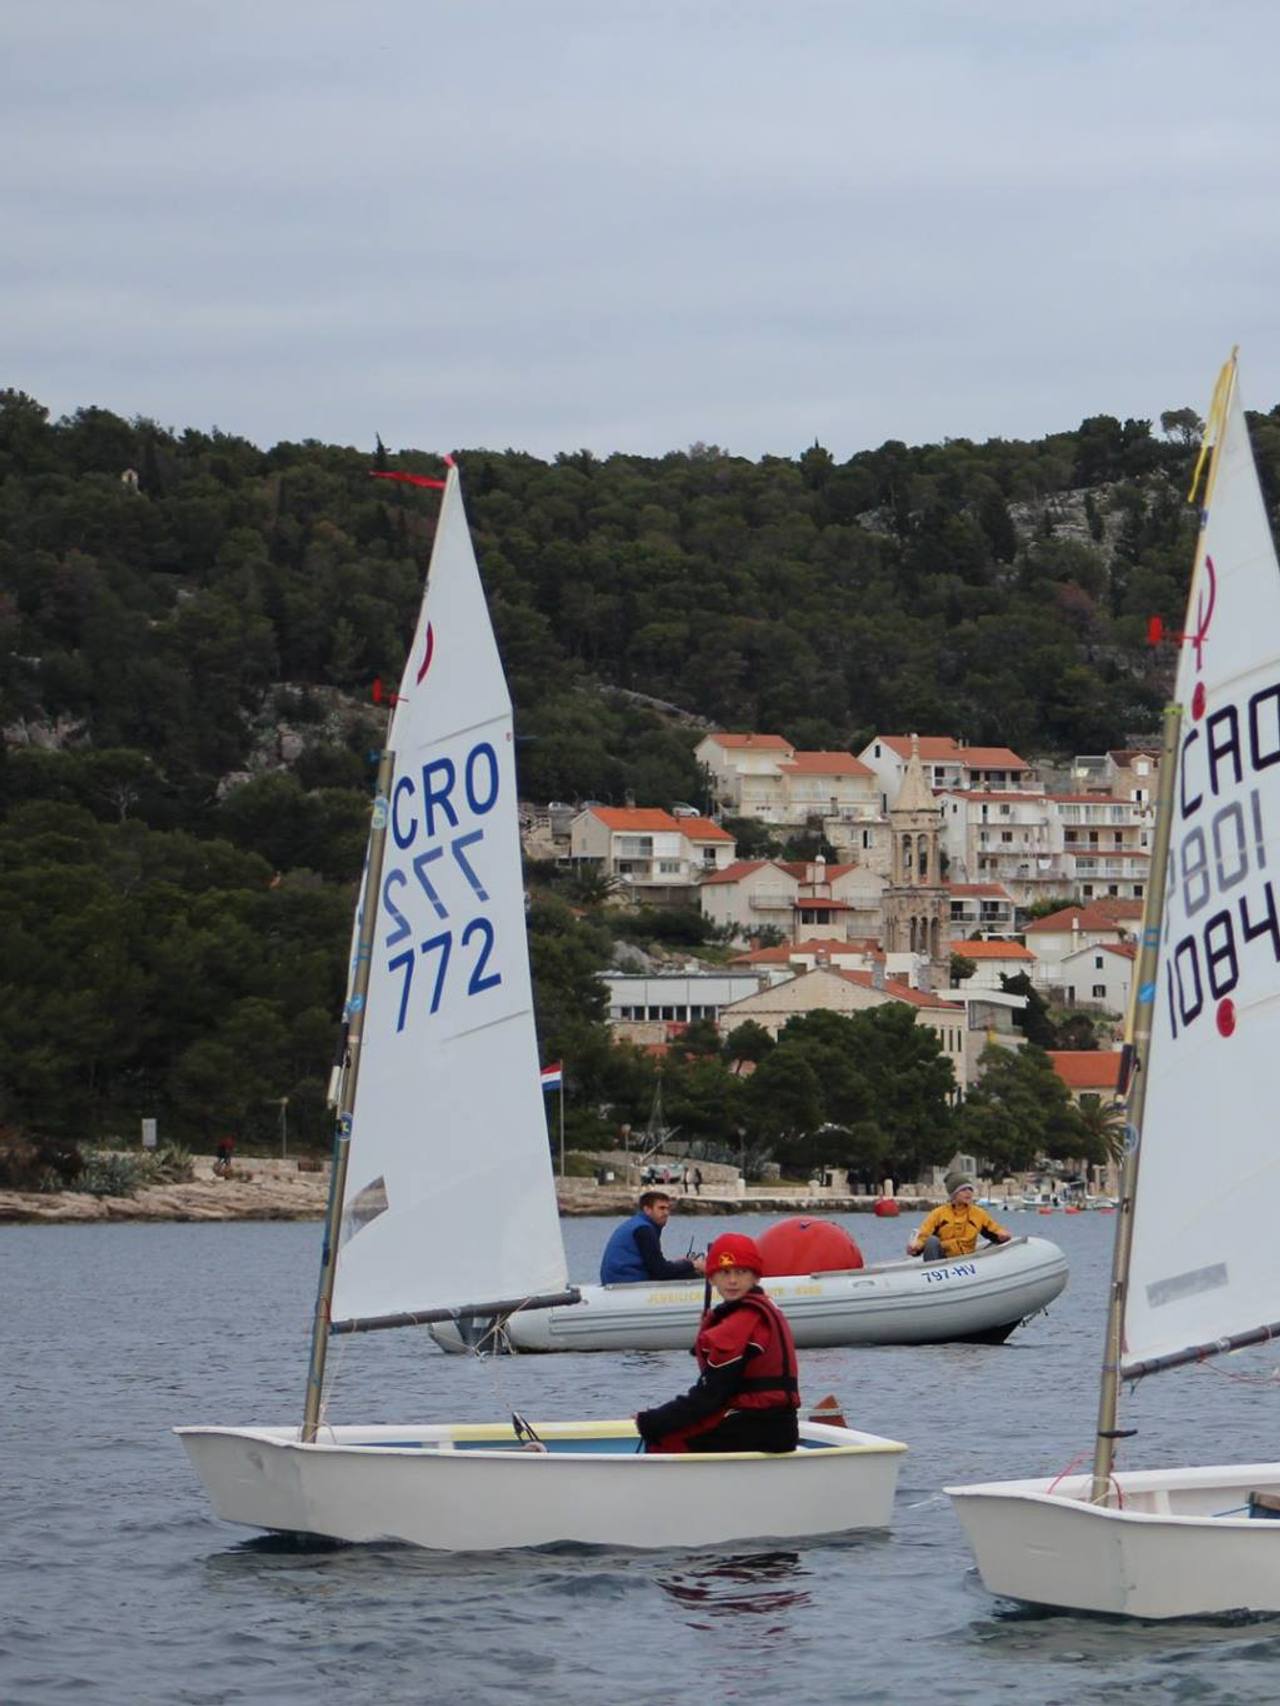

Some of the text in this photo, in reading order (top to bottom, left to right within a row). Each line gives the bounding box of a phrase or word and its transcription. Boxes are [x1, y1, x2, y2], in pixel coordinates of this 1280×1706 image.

[392, 742, 499, 850] CRO
[387, 917, 502, 1033] 772
[921, 1263, 977, 1283] 797-HV
